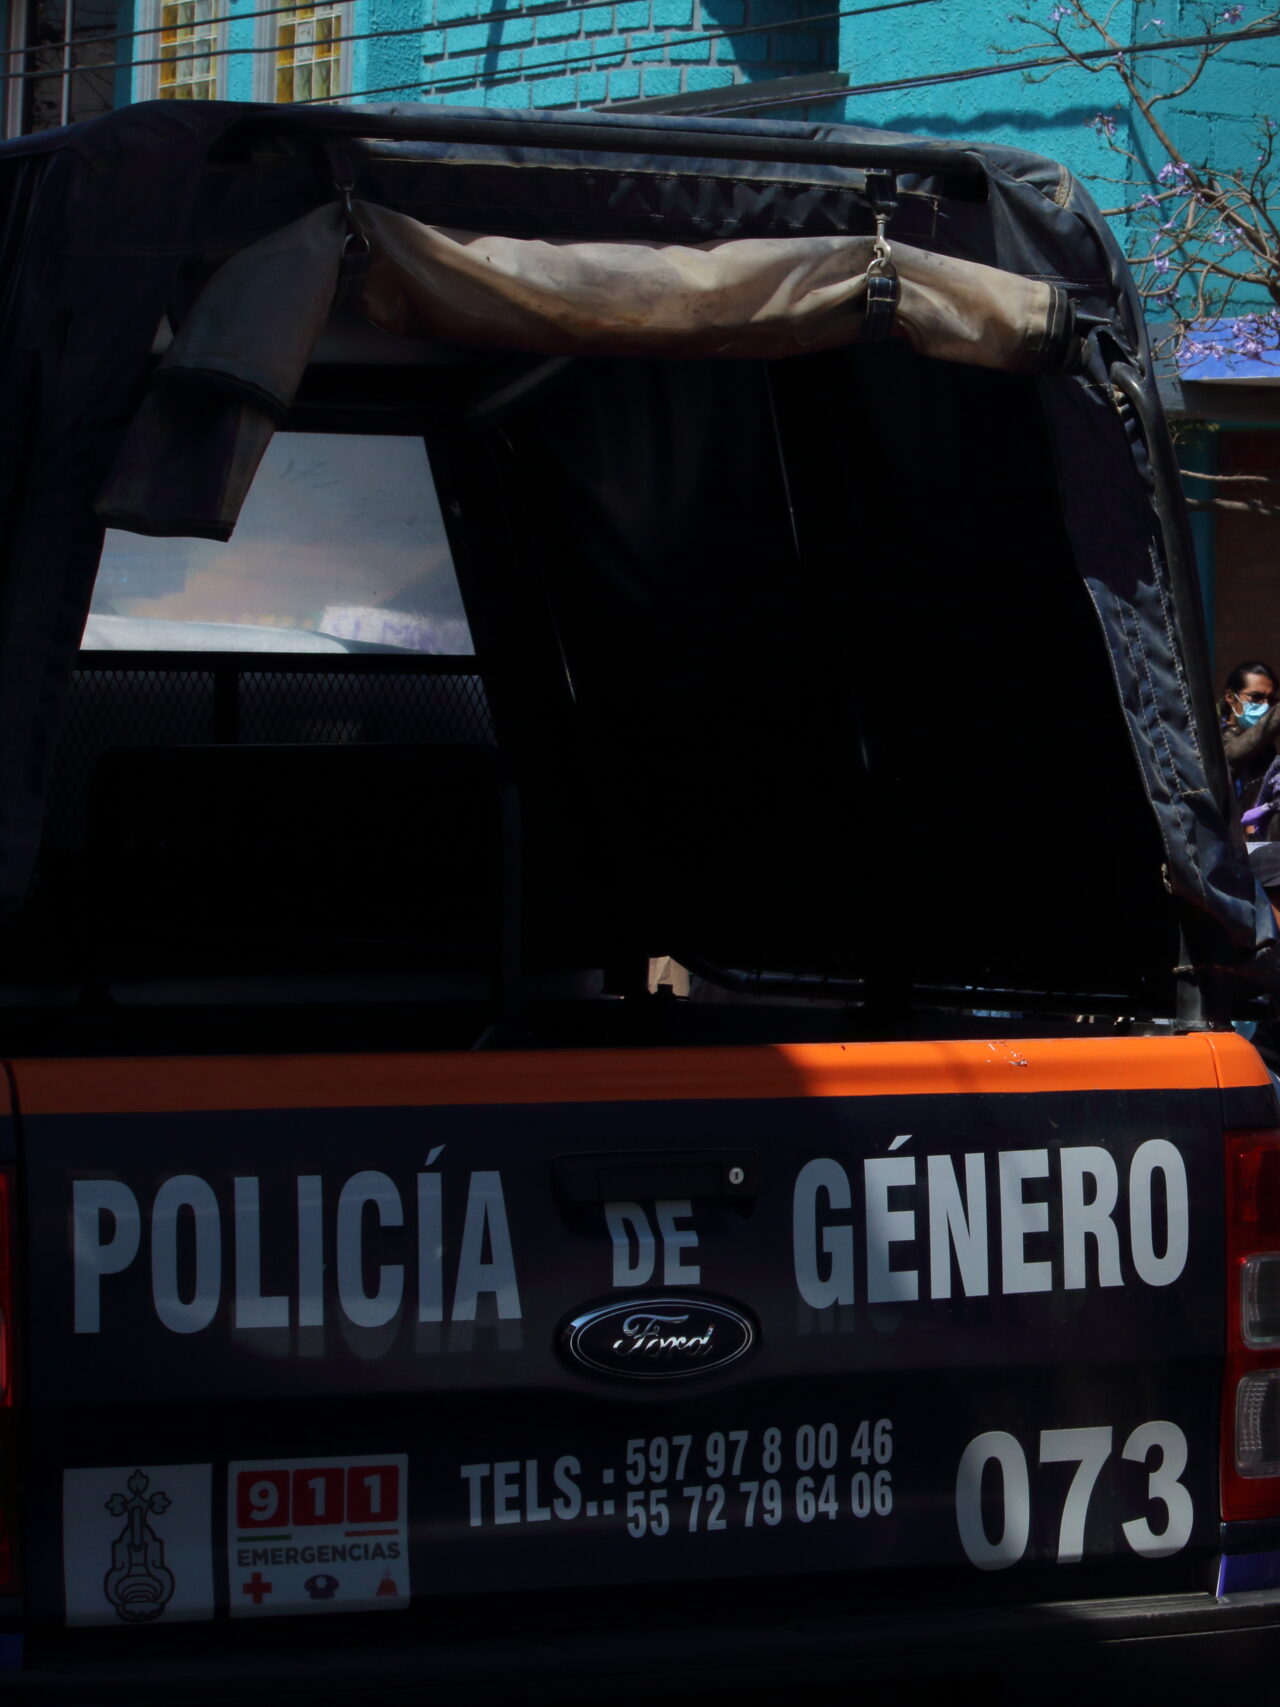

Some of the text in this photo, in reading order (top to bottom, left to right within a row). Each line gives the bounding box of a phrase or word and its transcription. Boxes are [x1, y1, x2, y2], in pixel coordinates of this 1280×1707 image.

[73, 1134, 1189, 1334] POLICÍA DE GÉNERO
[613, 1313, 714, 1358] Ford
[626, 1435, 692, 1485] 597
[706, 1430, 749, 1479] 97
[762, 1427, 782, 1473] 8
[795, 1423, 838, 1471] 00
[850, 1418, 893, 1465] 46
[249, 1474, 382, 1521] 911
[626, 1470, 893, 1538] 55 72 79 64 06
[955, 1420, 1194, 1570] 073
[238, 1542, 401, 1567] EMERGENCIAS
